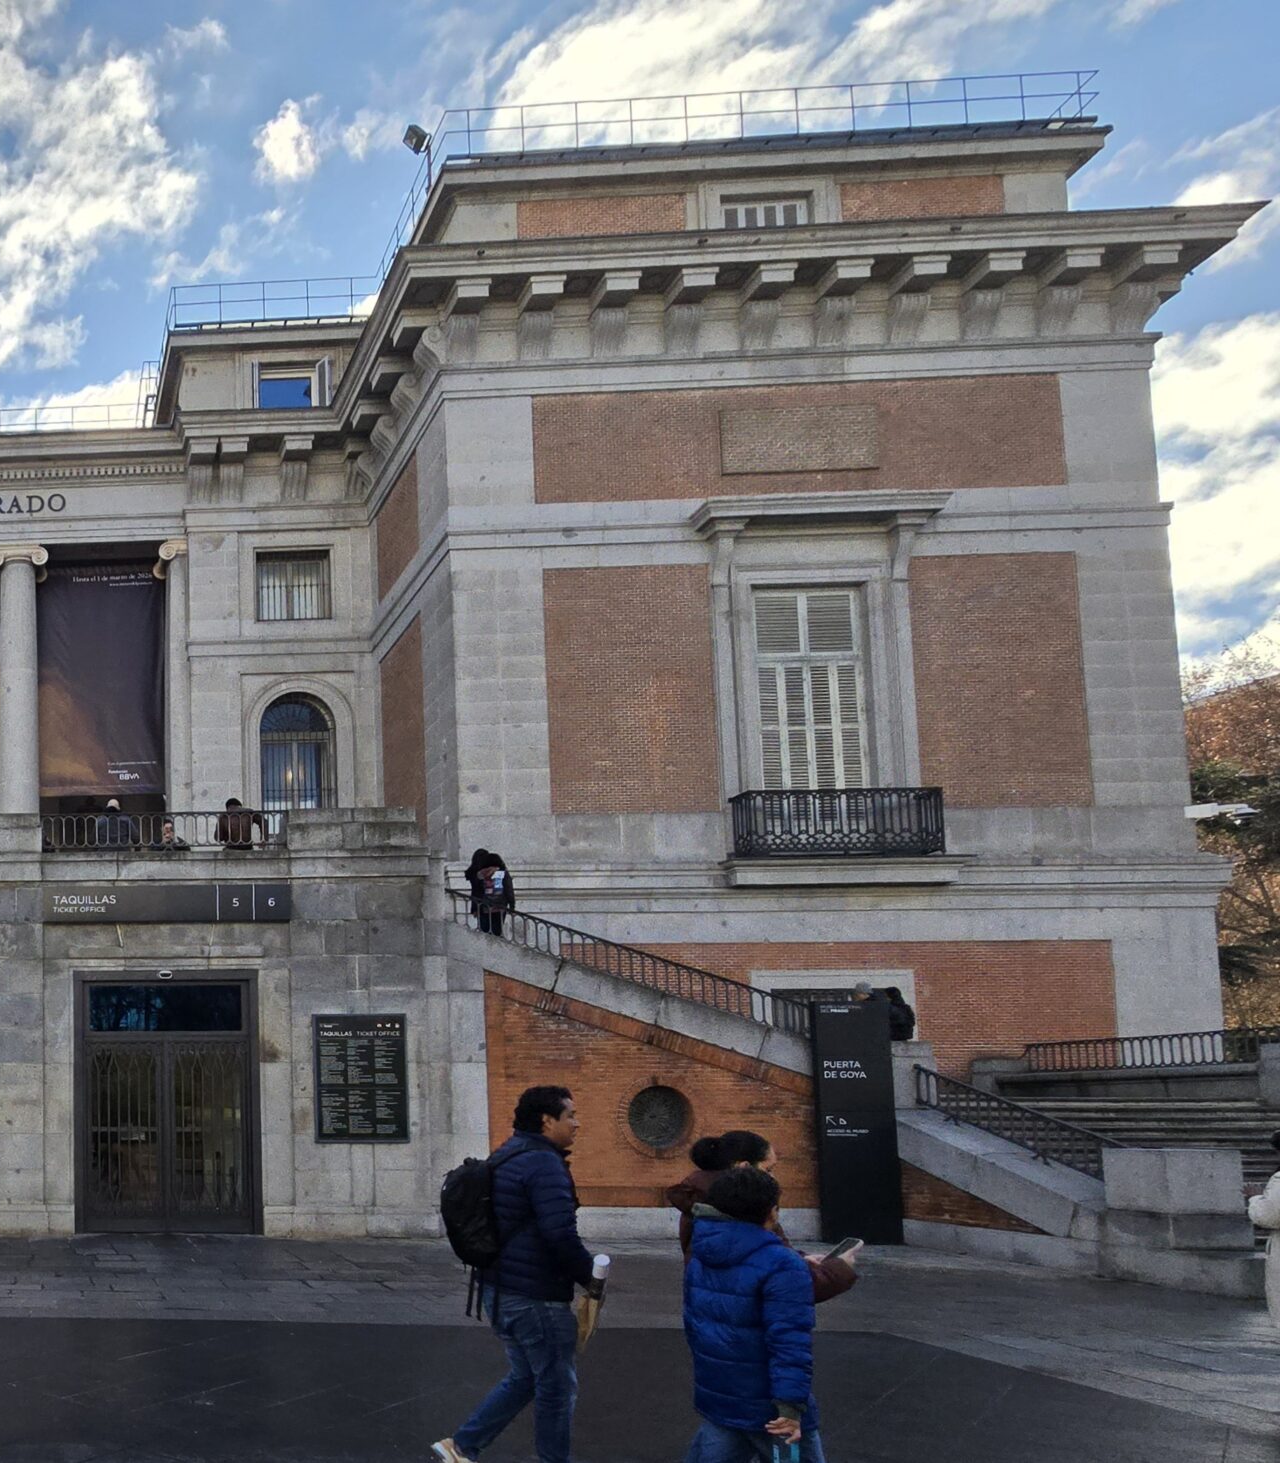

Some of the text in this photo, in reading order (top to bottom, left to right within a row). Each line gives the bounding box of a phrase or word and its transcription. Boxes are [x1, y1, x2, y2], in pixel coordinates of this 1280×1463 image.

[52, 895, 117, 904] TAQUILLAS
[232, 898, 240, 907] 5
[267, 898, 276, 907] 6
[823, 1060, 861, 1068] PUERTA
[824, 1070, 867, 1078] DE GOYA
